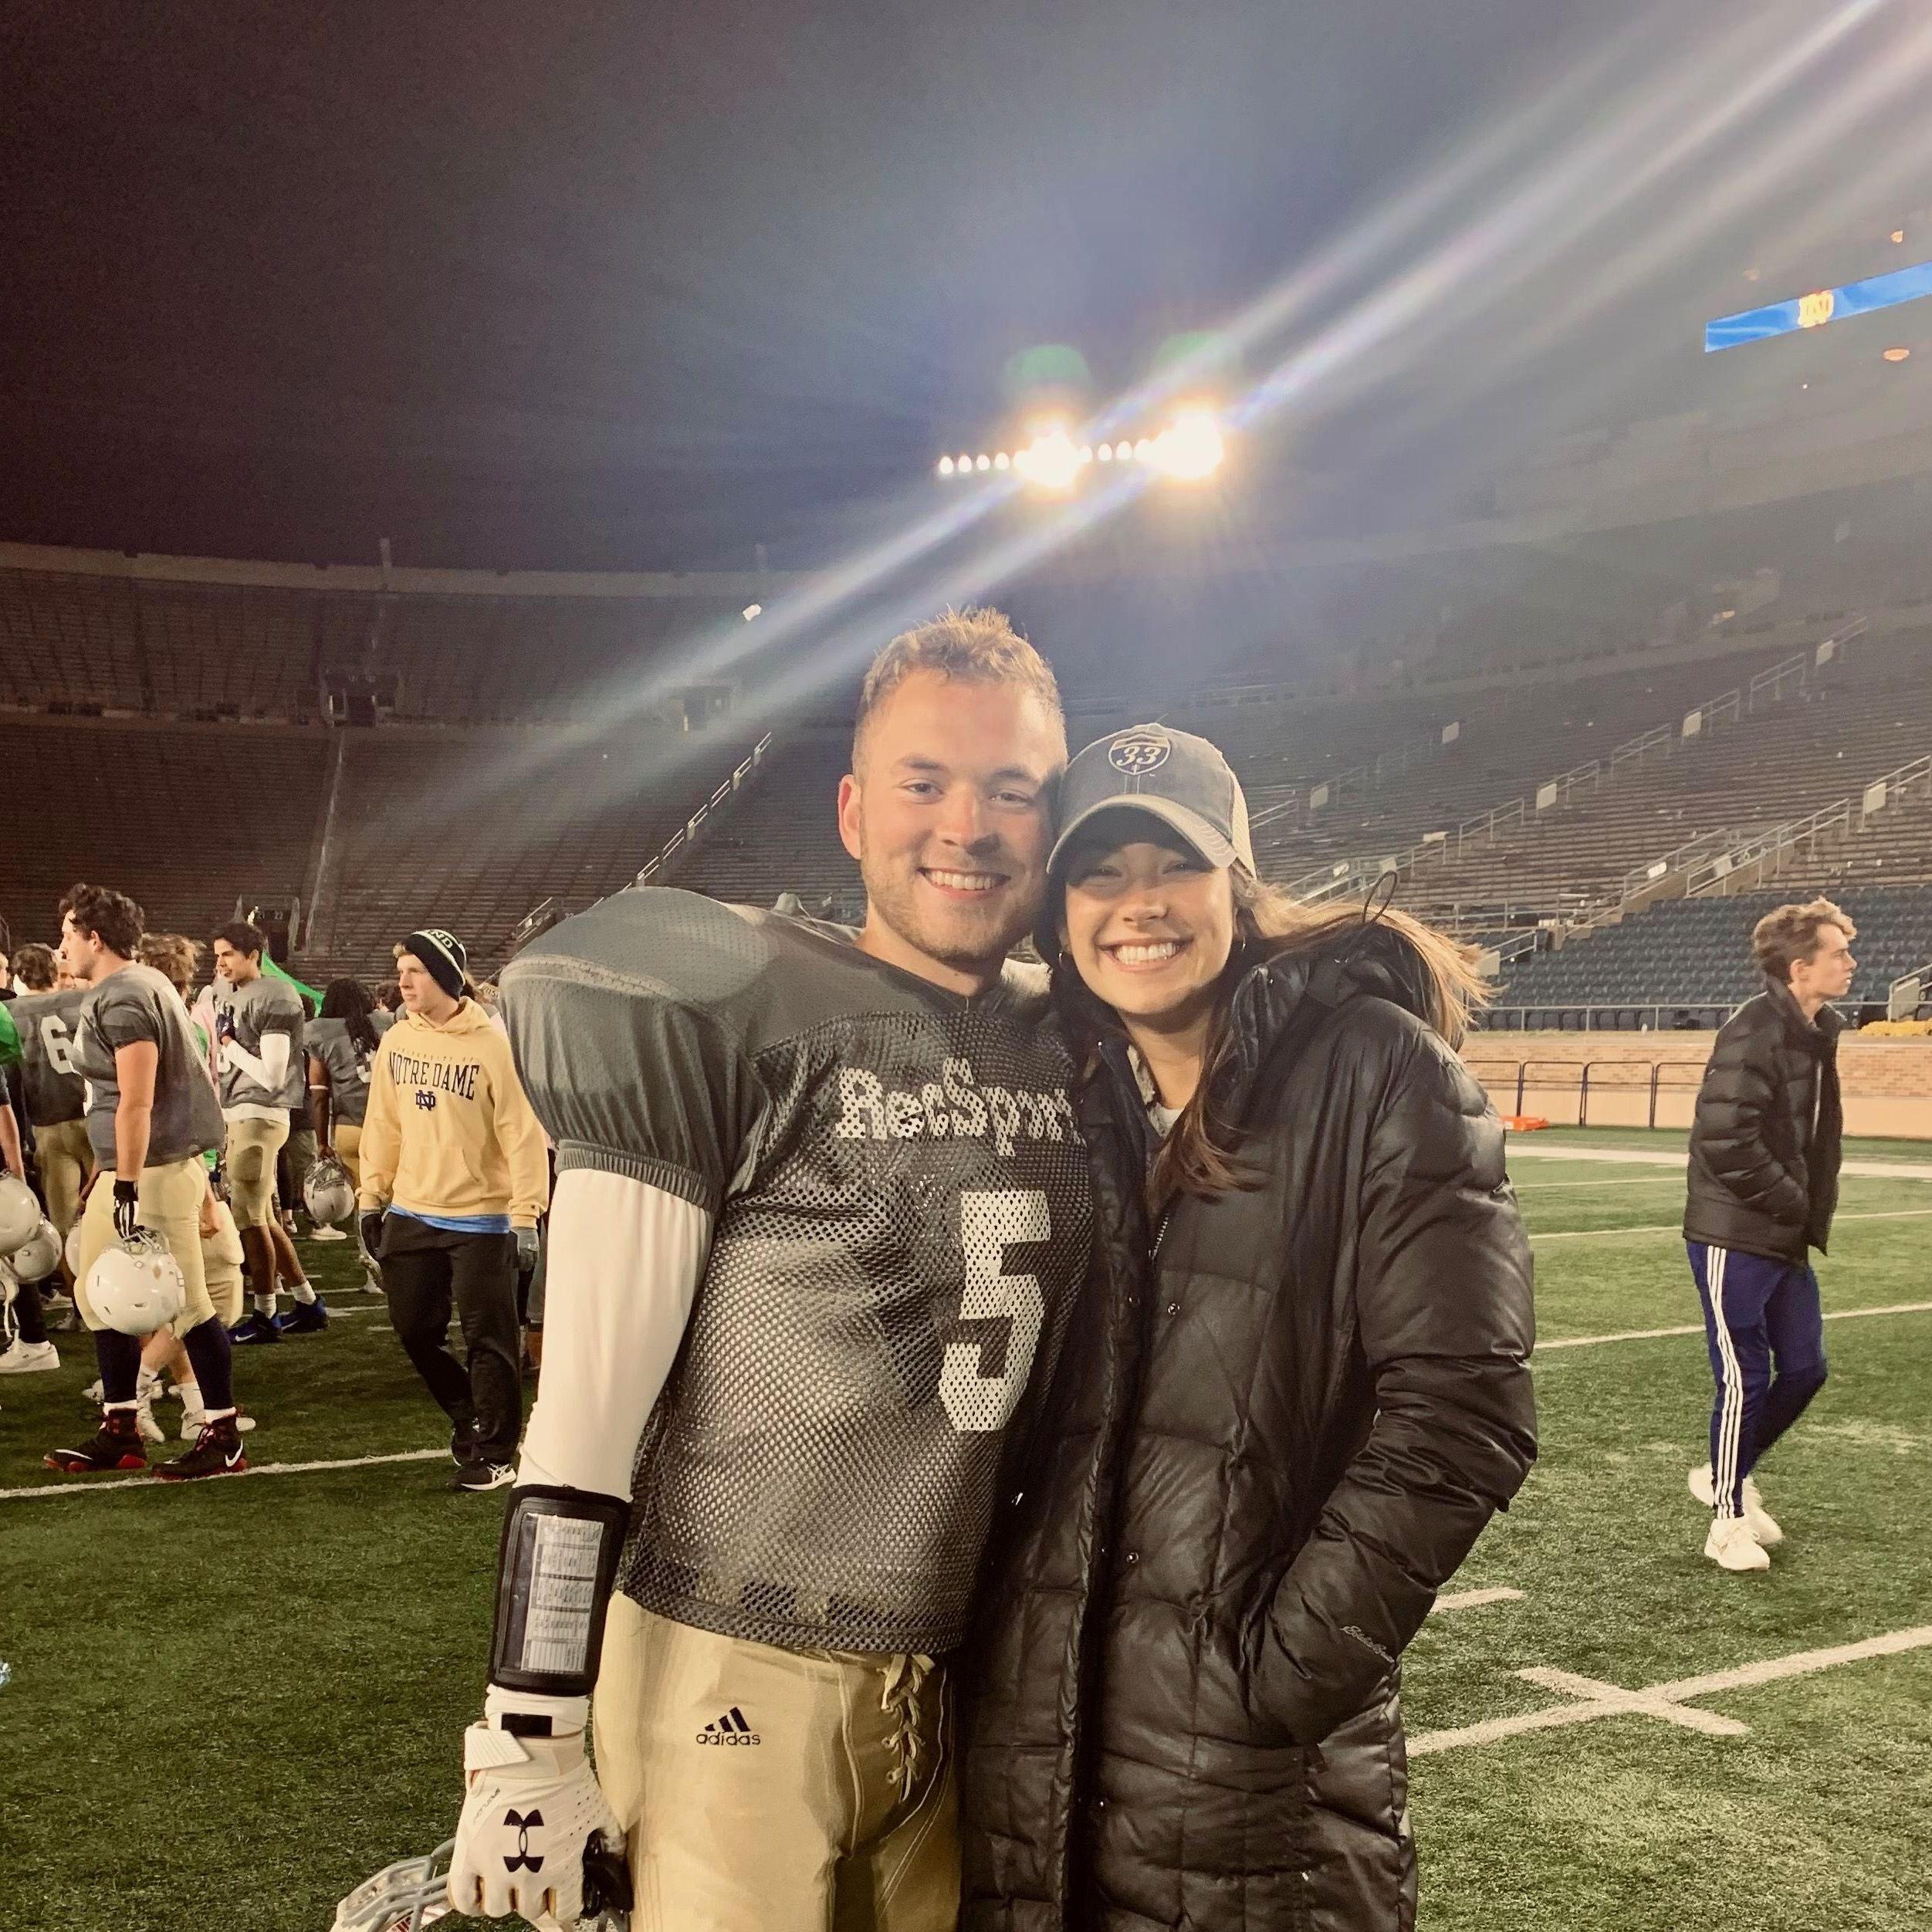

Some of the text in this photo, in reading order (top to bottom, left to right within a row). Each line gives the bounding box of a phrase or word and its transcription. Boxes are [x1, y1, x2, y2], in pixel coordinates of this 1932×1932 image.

[1116, 746, 1162, 766] 33
[389, 1051, 429, 1085] NOTRE
[432, 1064, 480, 1101] DAME
[938, 1189, 1051, 1433] 5
[696, 1732, 760, 1746] adidas
